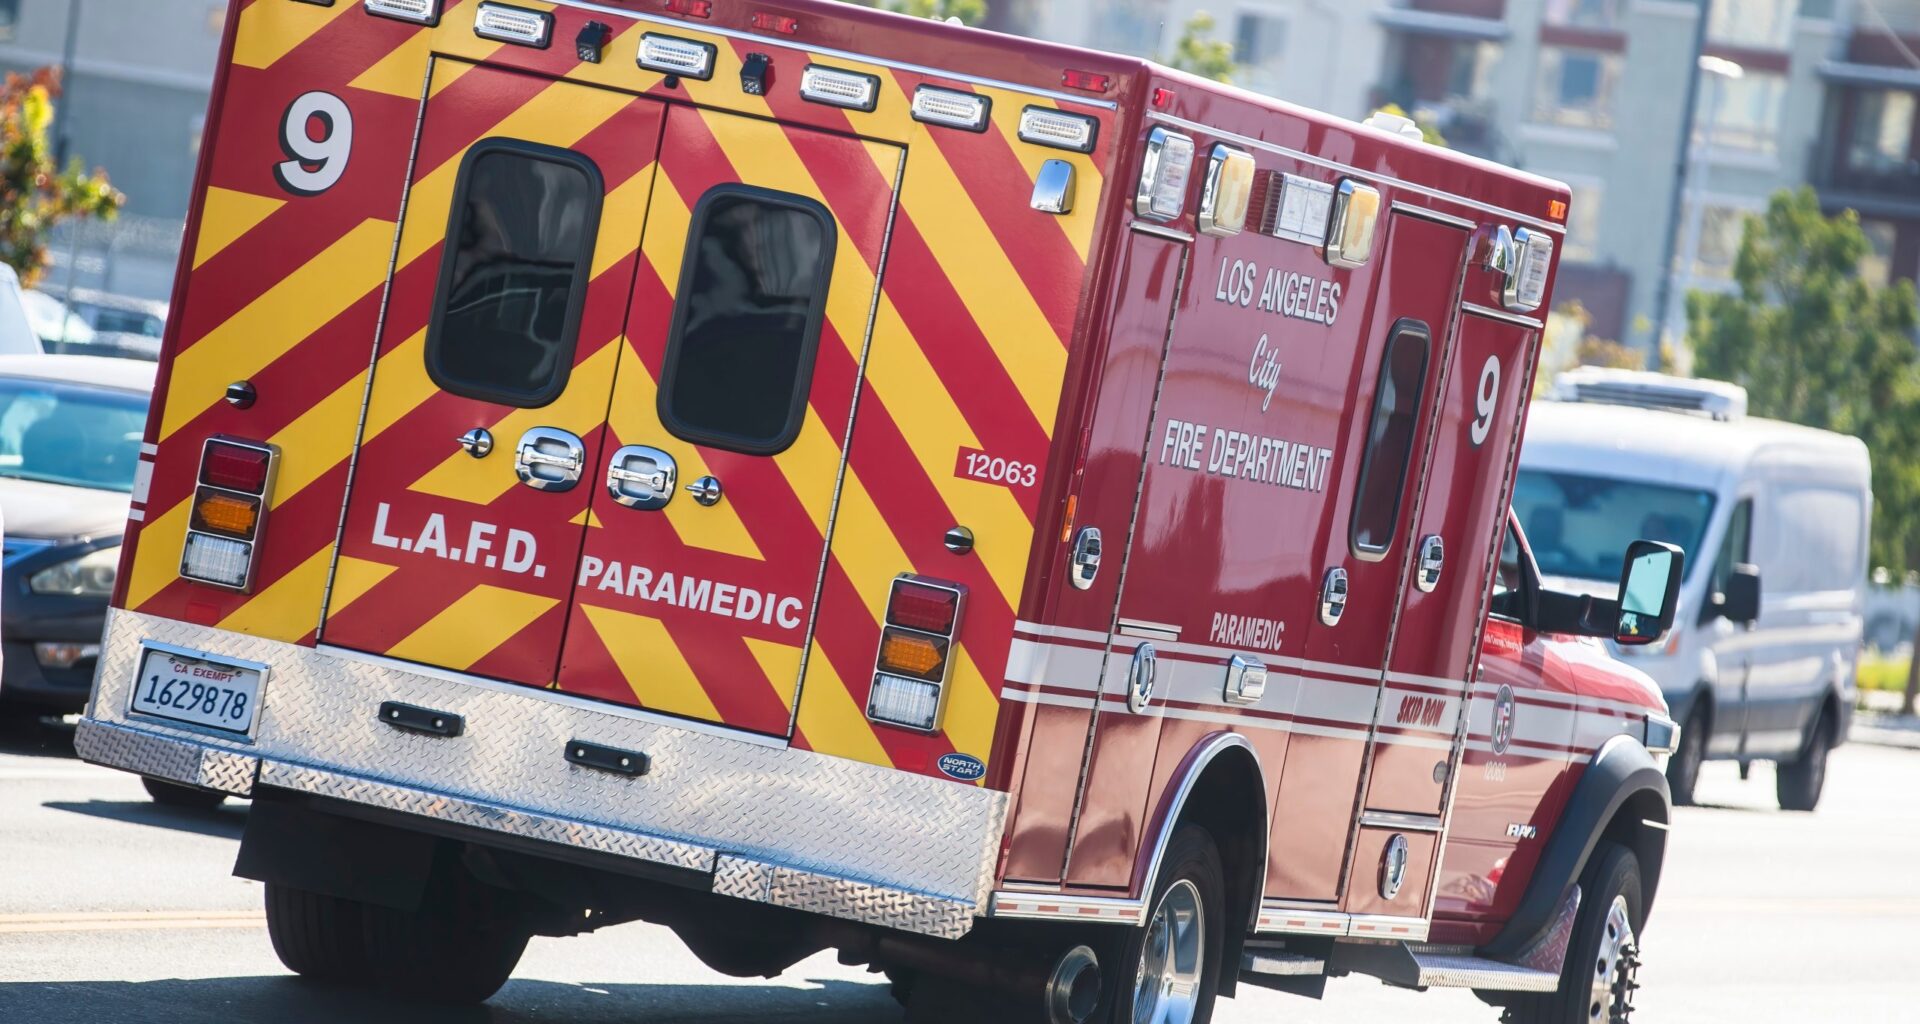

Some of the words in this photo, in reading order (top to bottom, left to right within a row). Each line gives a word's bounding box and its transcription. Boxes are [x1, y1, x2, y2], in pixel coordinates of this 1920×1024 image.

[274, 90, 353, 197] 9
[1215, 256, 1257, 307] LOS
[1256, 267, 1342, 326] ANGELES
[1248, 333, 1283, 413] City
[1470, 354, 1501, 447] 9
[966, 452, 1037, 487] 12063
[1159, 419, 1208, 471] FIRE
[1206, 427, 1333, 493] DEPARTMENT
[371, 502, 546, 578] L.A.F.D.
[578, 554, 803, 629] PARAMEDIC
[1209, 611, 1285, 652] PARAMEDIC
[143, 675, 248, 720] 1629878
[174, 664, 188, 674] CA
[193, 667, 234, 683] EXEMPT
[1396, 695, 1424, 724] SKID
[1420, 697, 1447, 728] ROW
[943, 756, 982, 770] NORTH
[943, 763, 973, 776] STAR
